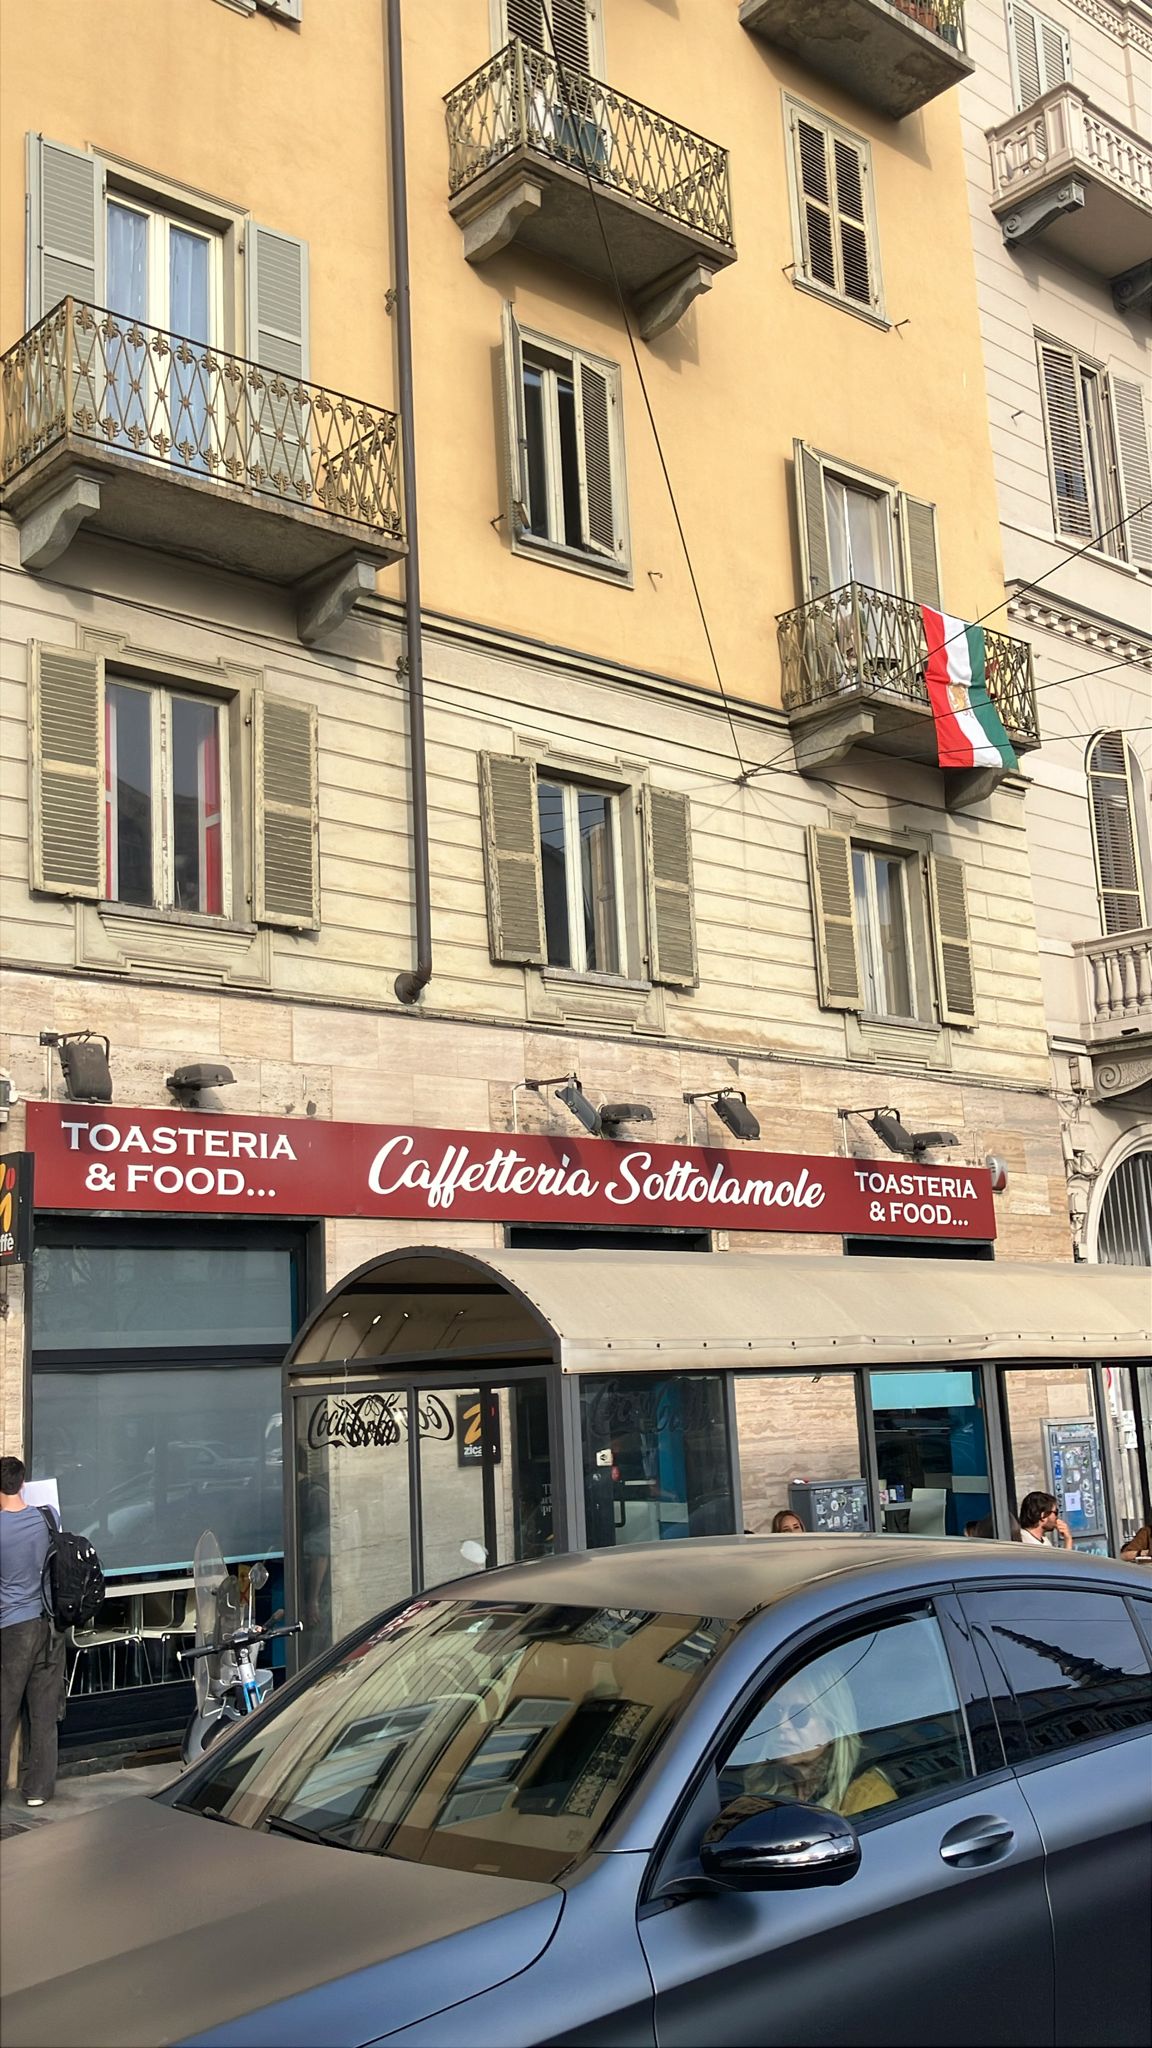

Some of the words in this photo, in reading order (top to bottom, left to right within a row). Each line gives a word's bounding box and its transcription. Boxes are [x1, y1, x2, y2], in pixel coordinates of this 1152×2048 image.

[61, 1120, 298, 1162] TOASTERIA
[84, 1163, 116, 1192] &
[126, 1164, 277, 1198] FOOD...
[367, 1135, 600, 1208] Caffetteria
[604, 1151, 826, 1208] Sottolamole
[853, 1171, 979, 1200] TOASTERIA
[869, 1200, 886, 1222] &
[889, 1201, 969, 1226] FOOD...
[0, 1232, 15, 1252] ffè
